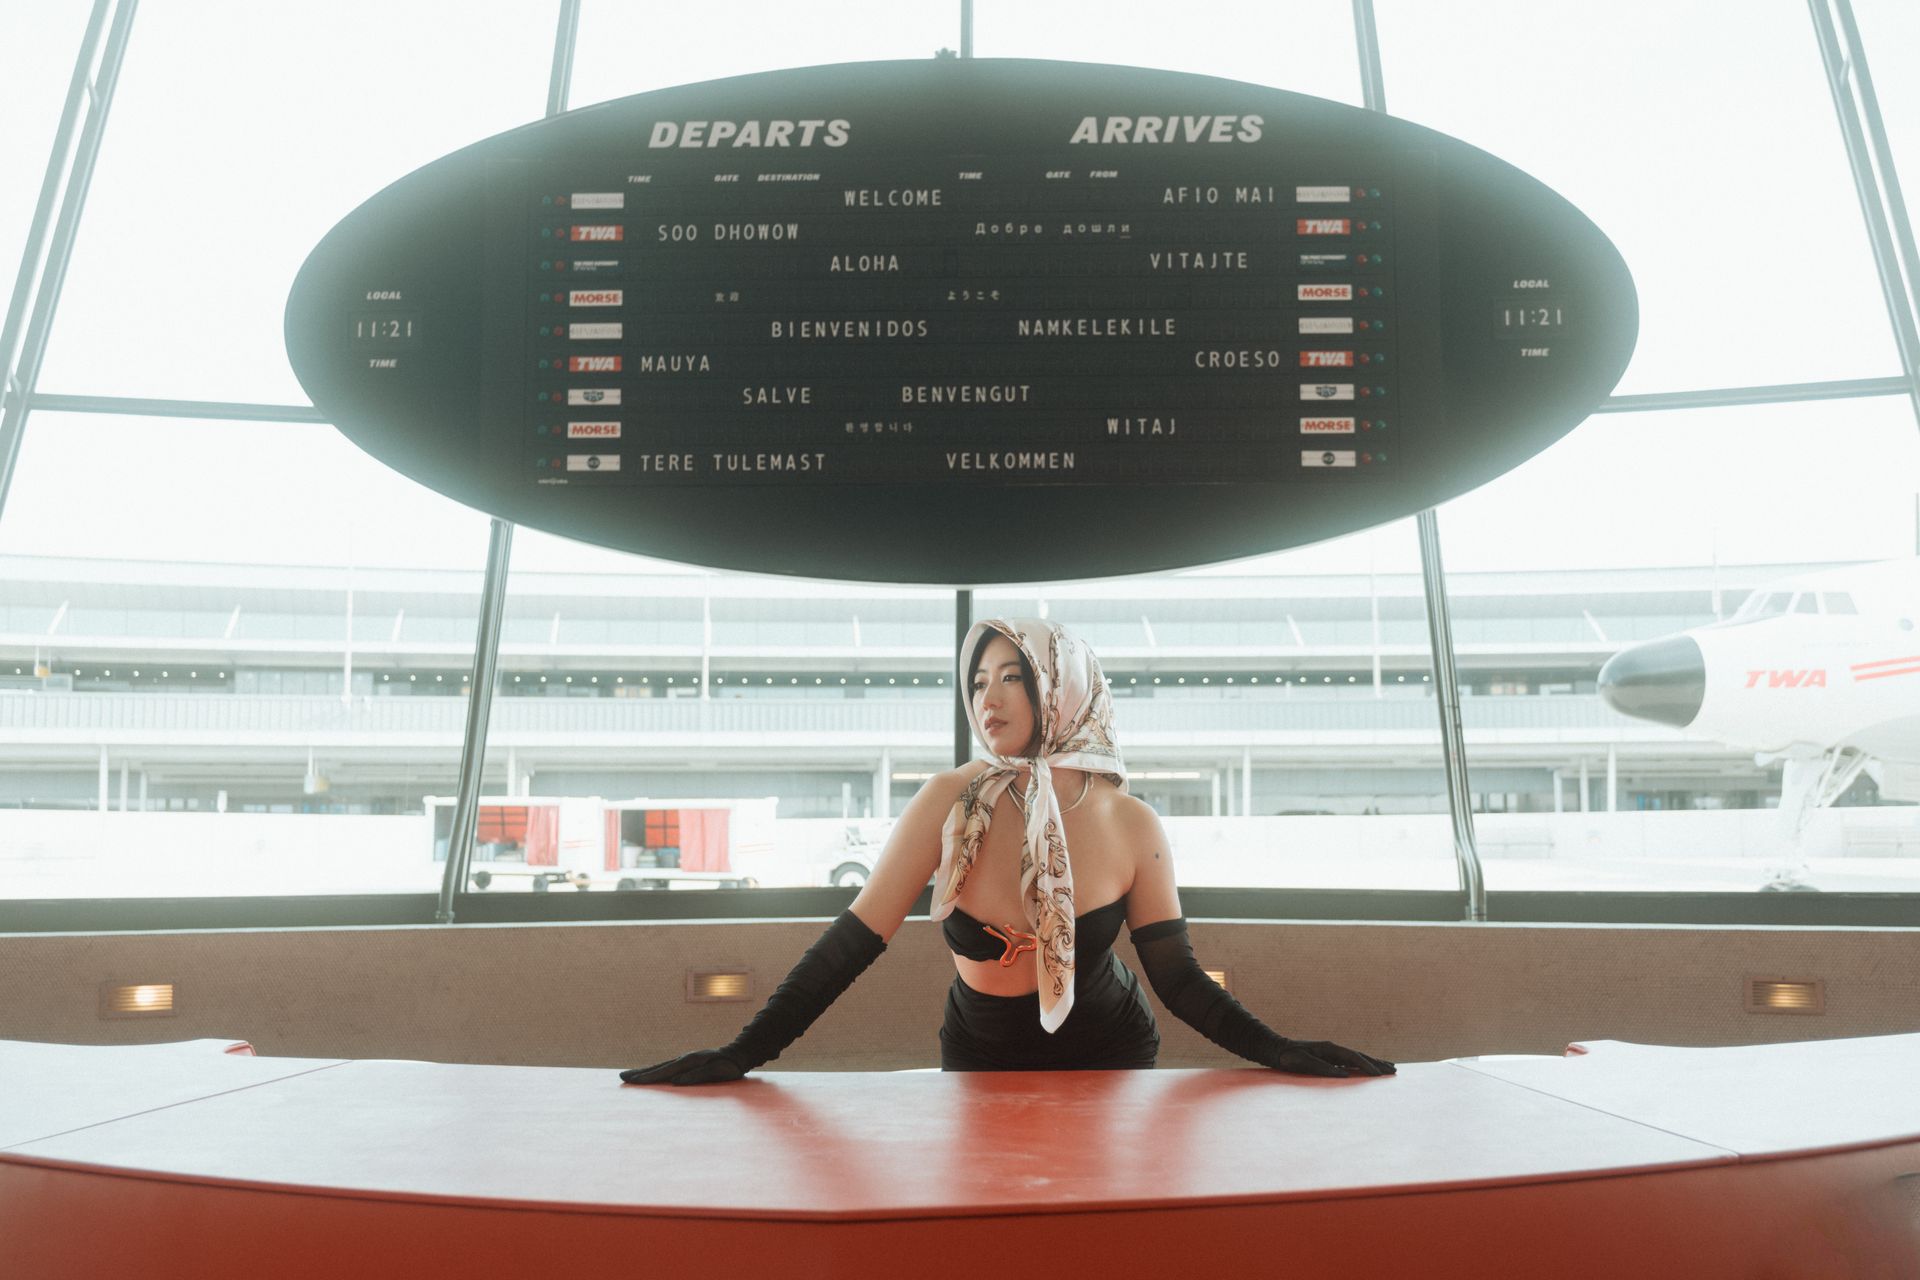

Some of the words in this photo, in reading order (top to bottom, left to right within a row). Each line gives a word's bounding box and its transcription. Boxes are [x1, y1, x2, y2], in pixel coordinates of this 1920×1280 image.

[648, 118, 851, 148] DEPARTS
[1069, 114, 1265, 144] ARRIVES
[628, 175, 652, 183] TIME
[714, 174, 740, 182] GATE
[757, 173, 821, 182] DESTINATION
[959, 171, 983, 180] TIME
[1045, 170, 1071, 179] GATE
[1089, 170, 1118, 179] FROM
[844, 189, 942, 207] WELCOME
[1163, 186, 1219, 204] AFIO
[1235, 186, 1273, 203] MAI
[578, 225, 617, 240] TWA
[658, 224, 698, 242] SOO
[714, 223, 799, 241] DHOWOW
[975, 222, 1043, 236] Добре
[1062, 223, 1130, 236] дошли
[1304, 219, 1344, 235] TWA
[830, 254, 899, 272] ALOHA
[1149, 251, 1248, 269] VITAJTE
[1512, 279, 1550, 289] LOCAL
[366, 290, 402, 300] LOCAL
[573, 293, 619, 304] MORSE
[1301, 287, 1349, 298] MORSE
[1504, 308, 1562, 326] 11:21
[357, 320, 412, 338] 11:21
[771, 319, 928, 338] BIENVENIDOS
[1018, 318, 1175, 336] NAMKELEKILE
[1194, 350, 1280, 368] CROESO
[1307, 352, 1346, 366] TWA
[1520, 347, 1550, 357] TIME
[369, 358, 397, 368] TIME
[577, 356, 616, 371] TWA
[641, 354, 710, 372] MAUYA
[743, 387, 811, 405] SALVE
[902, 385, 1030, 403] BENVENGUT
[571, 424, 618, 436] MORSE
[1106, 418, 1176, 435] WITAJ
[1304, 420, 1351, 431] MORSE
[640, 453, 694, 472] TERE
[713, 453, 825, 471] TULEMAST
[946, 452, 1075, 470] VELKOMMEN
[1744, 668, 1828, 689] TWA
